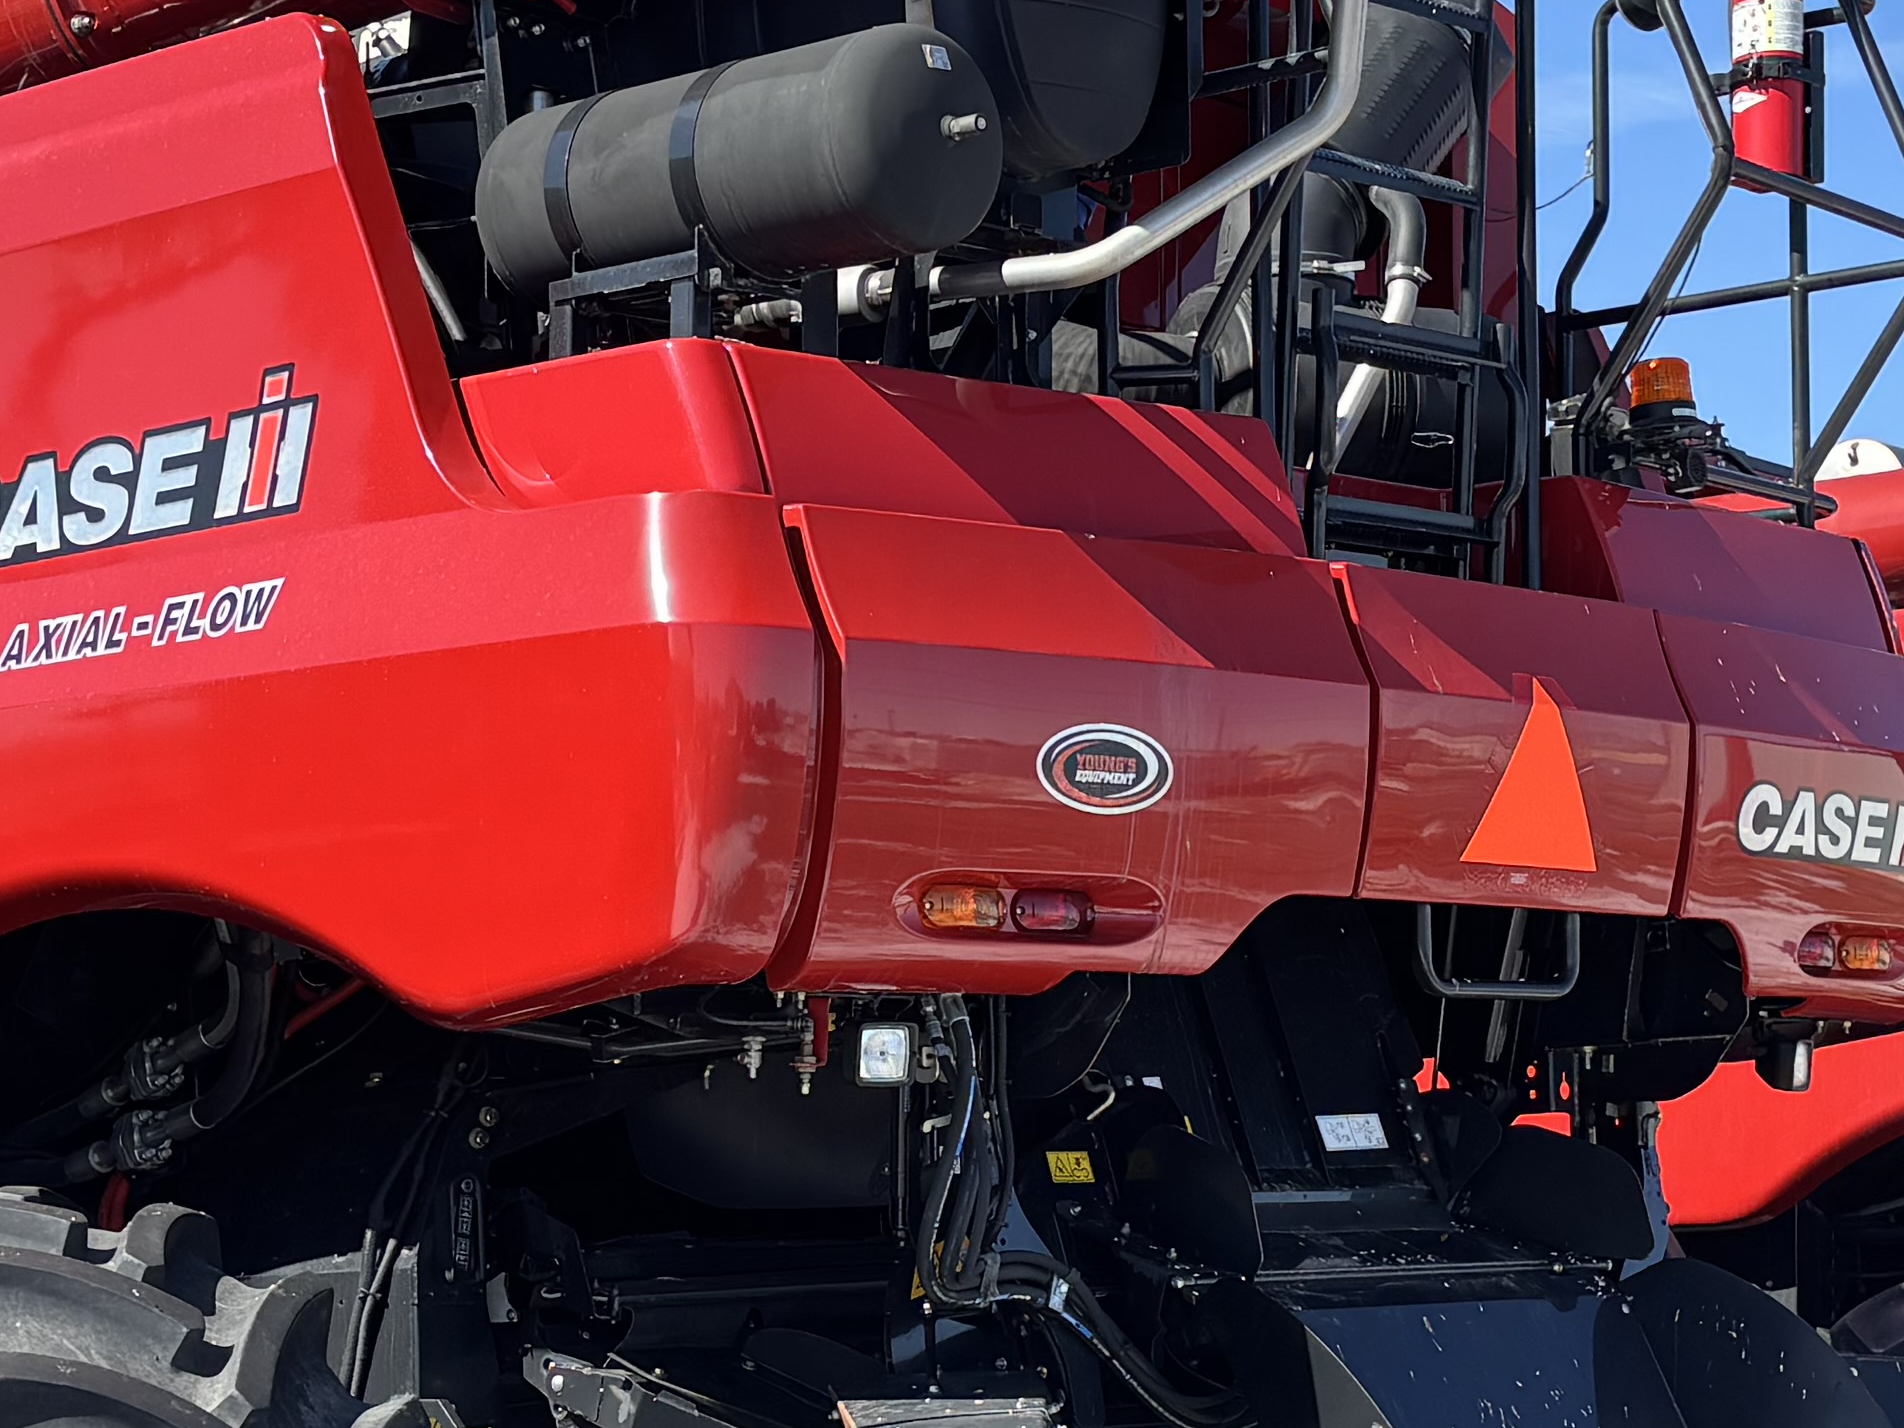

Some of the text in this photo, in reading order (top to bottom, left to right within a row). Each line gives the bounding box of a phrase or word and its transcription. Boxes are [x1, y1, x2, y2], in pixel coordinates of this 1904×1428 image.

[1076, 753, 1137, 772] YOUNG'S
[1075, 769, 1137, 785] EQUIPMENT
[1737, 782, 1890, 864] CASE
